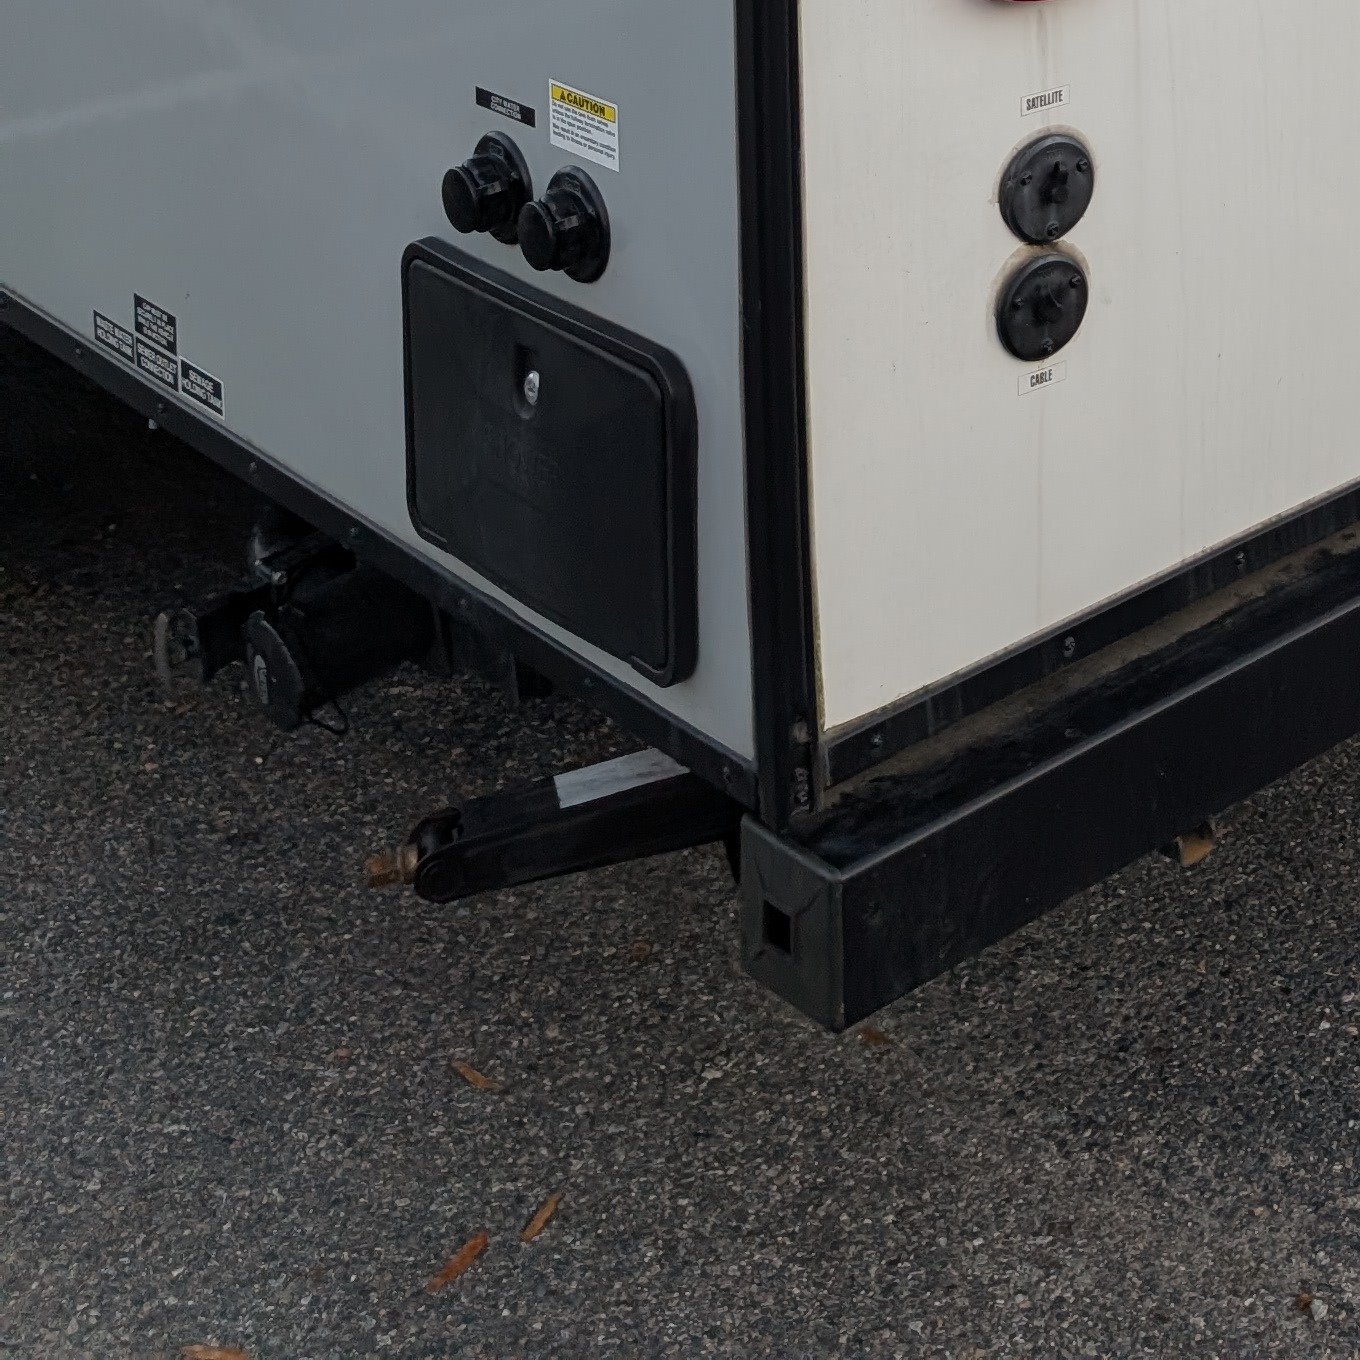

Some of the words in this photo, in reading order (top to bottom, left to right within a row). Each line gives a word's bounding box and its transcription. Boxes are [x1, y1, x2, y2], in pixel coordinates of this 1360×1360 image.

[566, 93, 606, 117] CAUTION
[1026, 89, 1064, 112] SATELLITE
[1030, 368, 1053, 389] CABLE
